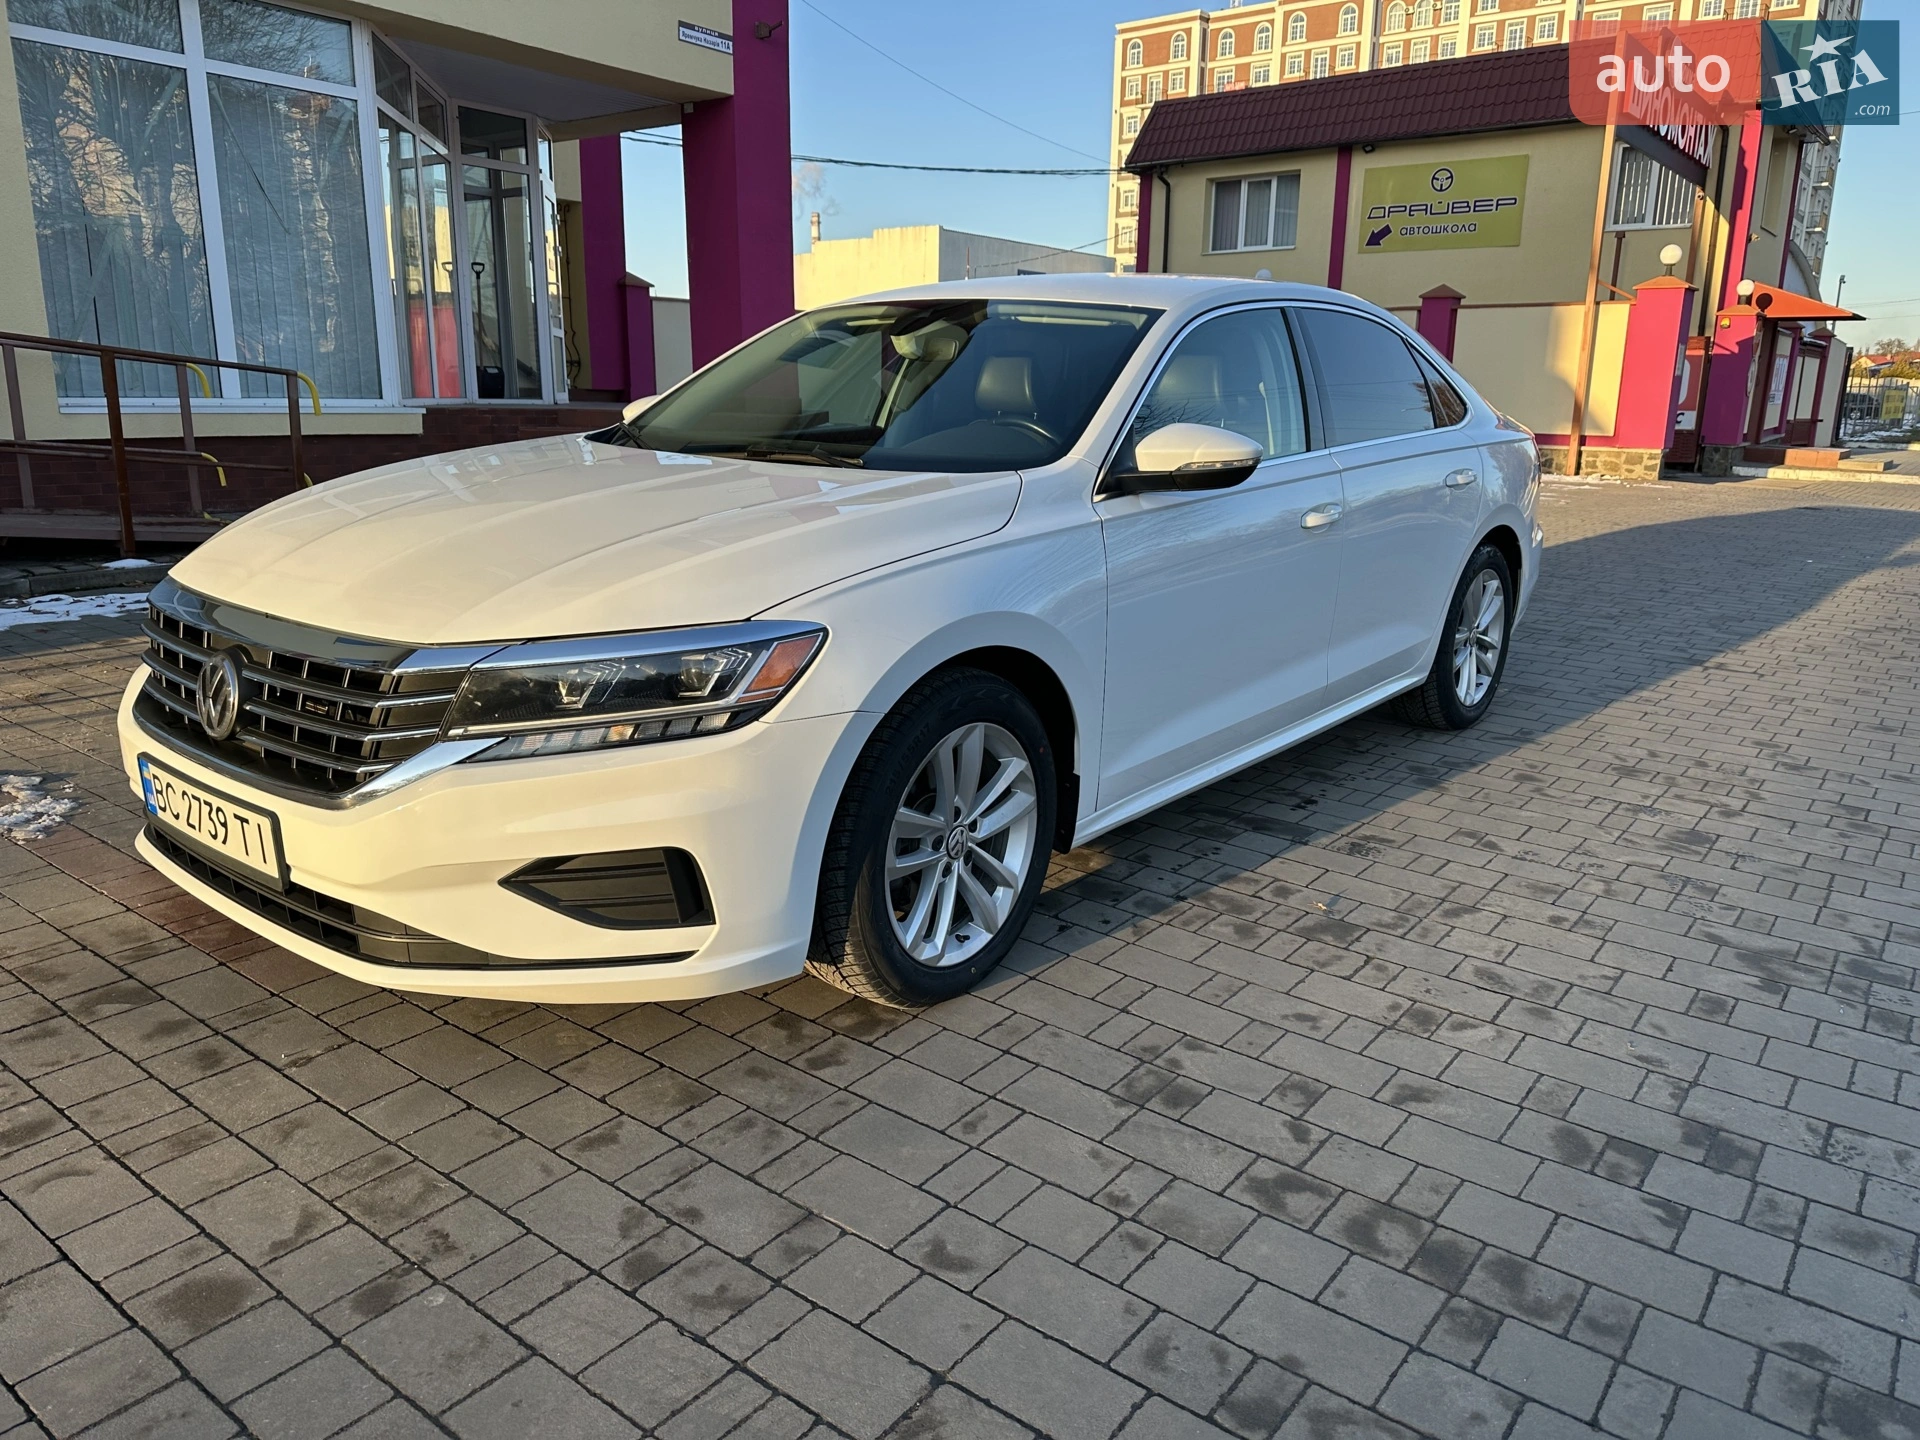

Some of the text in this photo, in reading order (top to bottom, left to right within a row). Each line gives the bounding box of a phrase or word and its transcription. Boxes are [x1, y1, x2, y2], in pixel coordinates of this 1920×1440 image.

[1367, 196, 1517, 220] ДРАЙВЕР
[1399, 222, 1477, 237] автошкола
[152, 774, 267, 864] BC 2739 TI
